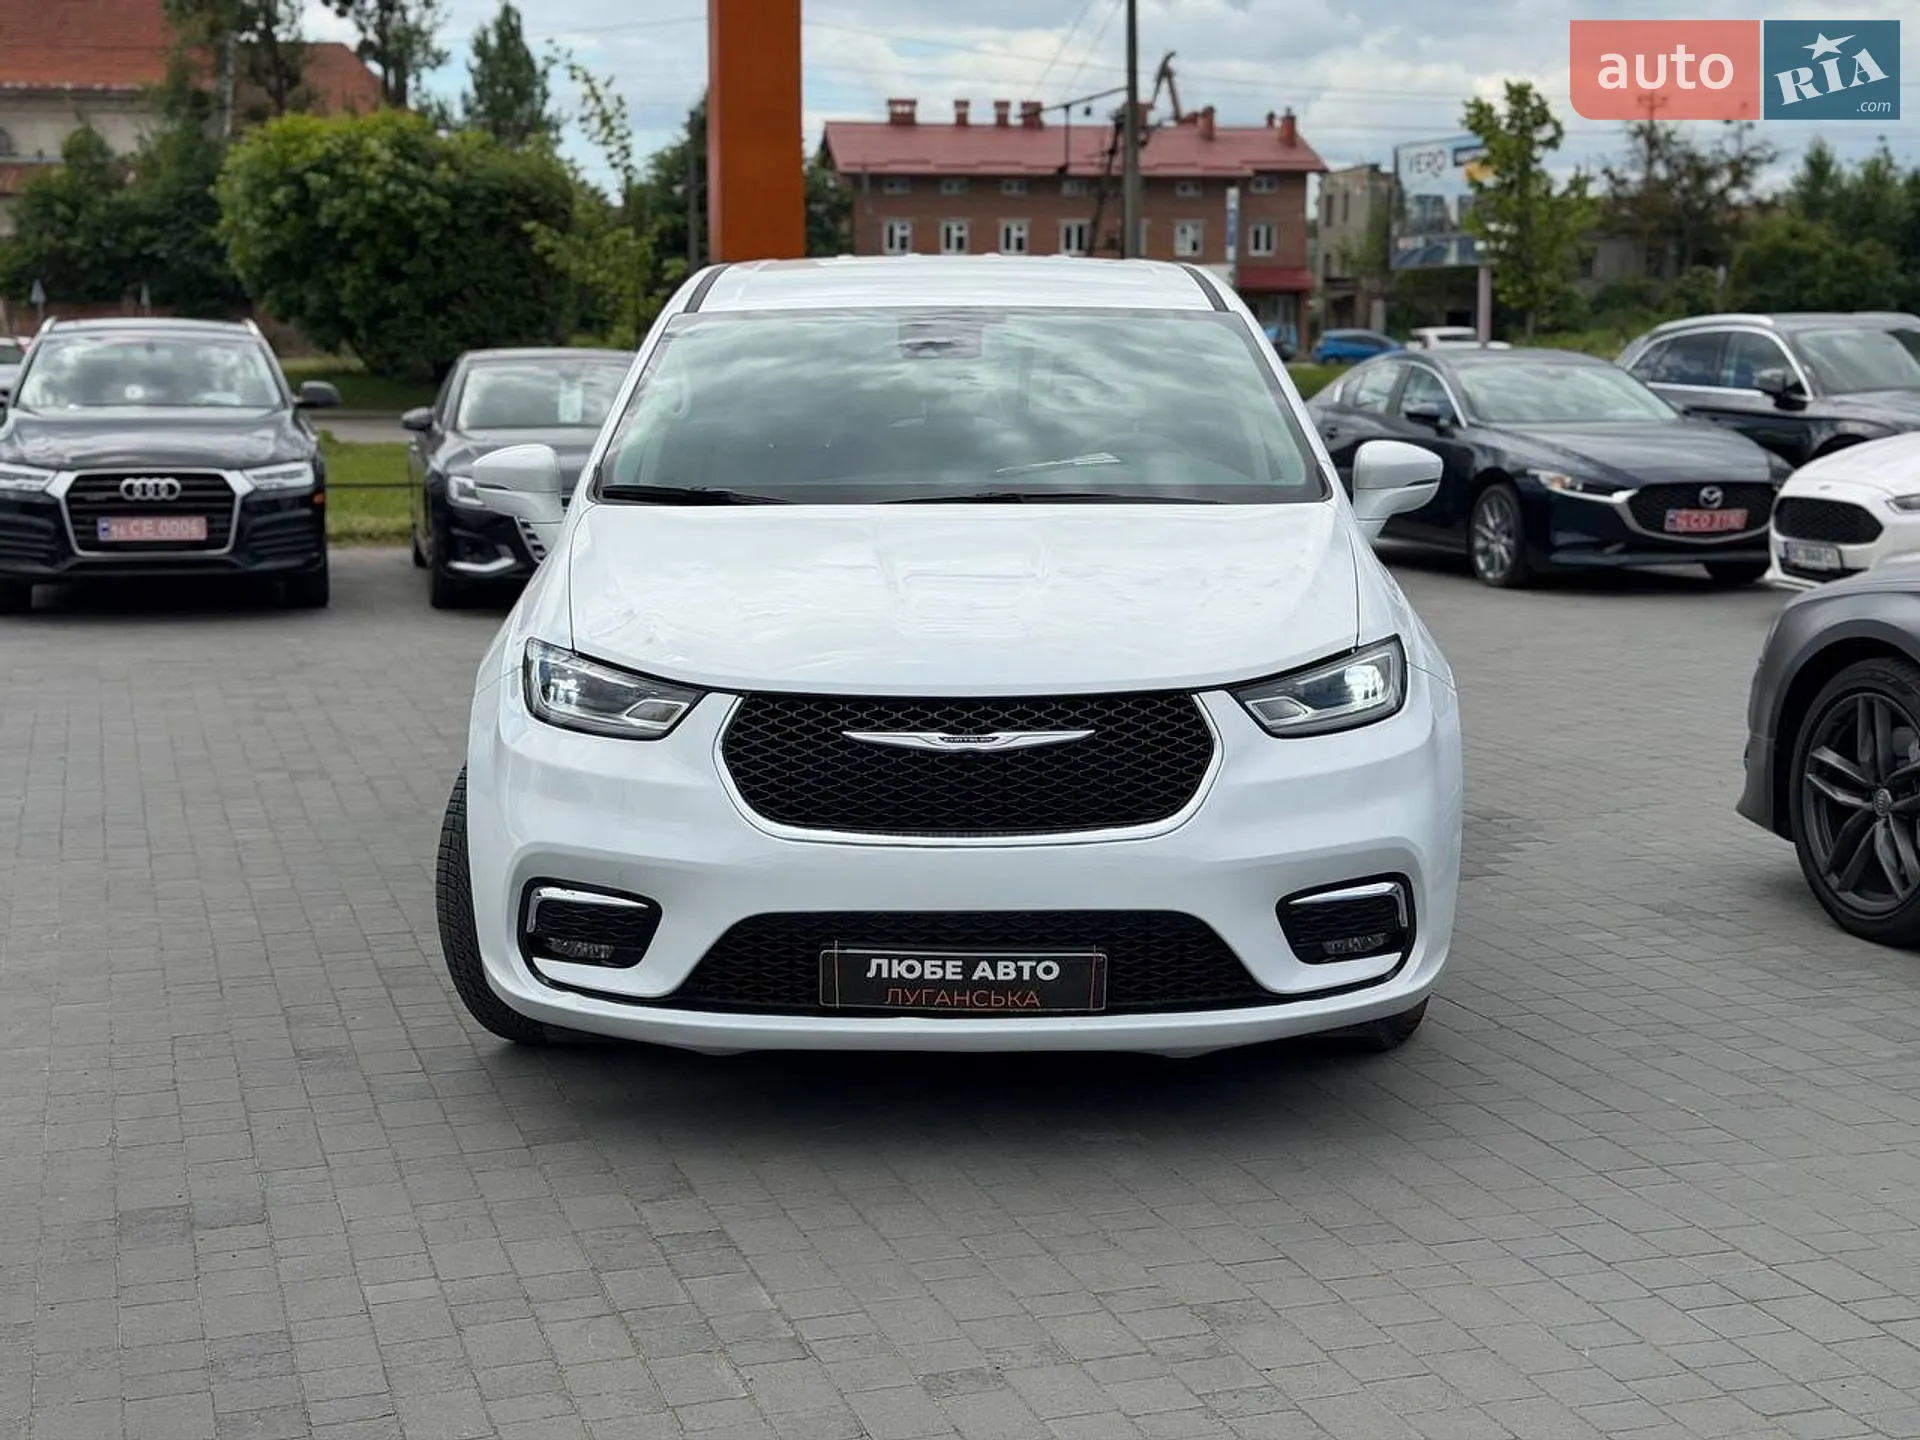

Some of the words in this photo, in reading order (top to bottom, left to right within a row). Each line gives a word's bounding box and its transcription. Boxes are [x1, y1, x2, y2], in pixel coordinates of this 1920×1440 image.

[866, 958, 964, 981] ЛЮБЕ
[971, 959, 1061, 982] АВТО
[884, 987, 1041, 1008] ЛУГАНСЬКА
